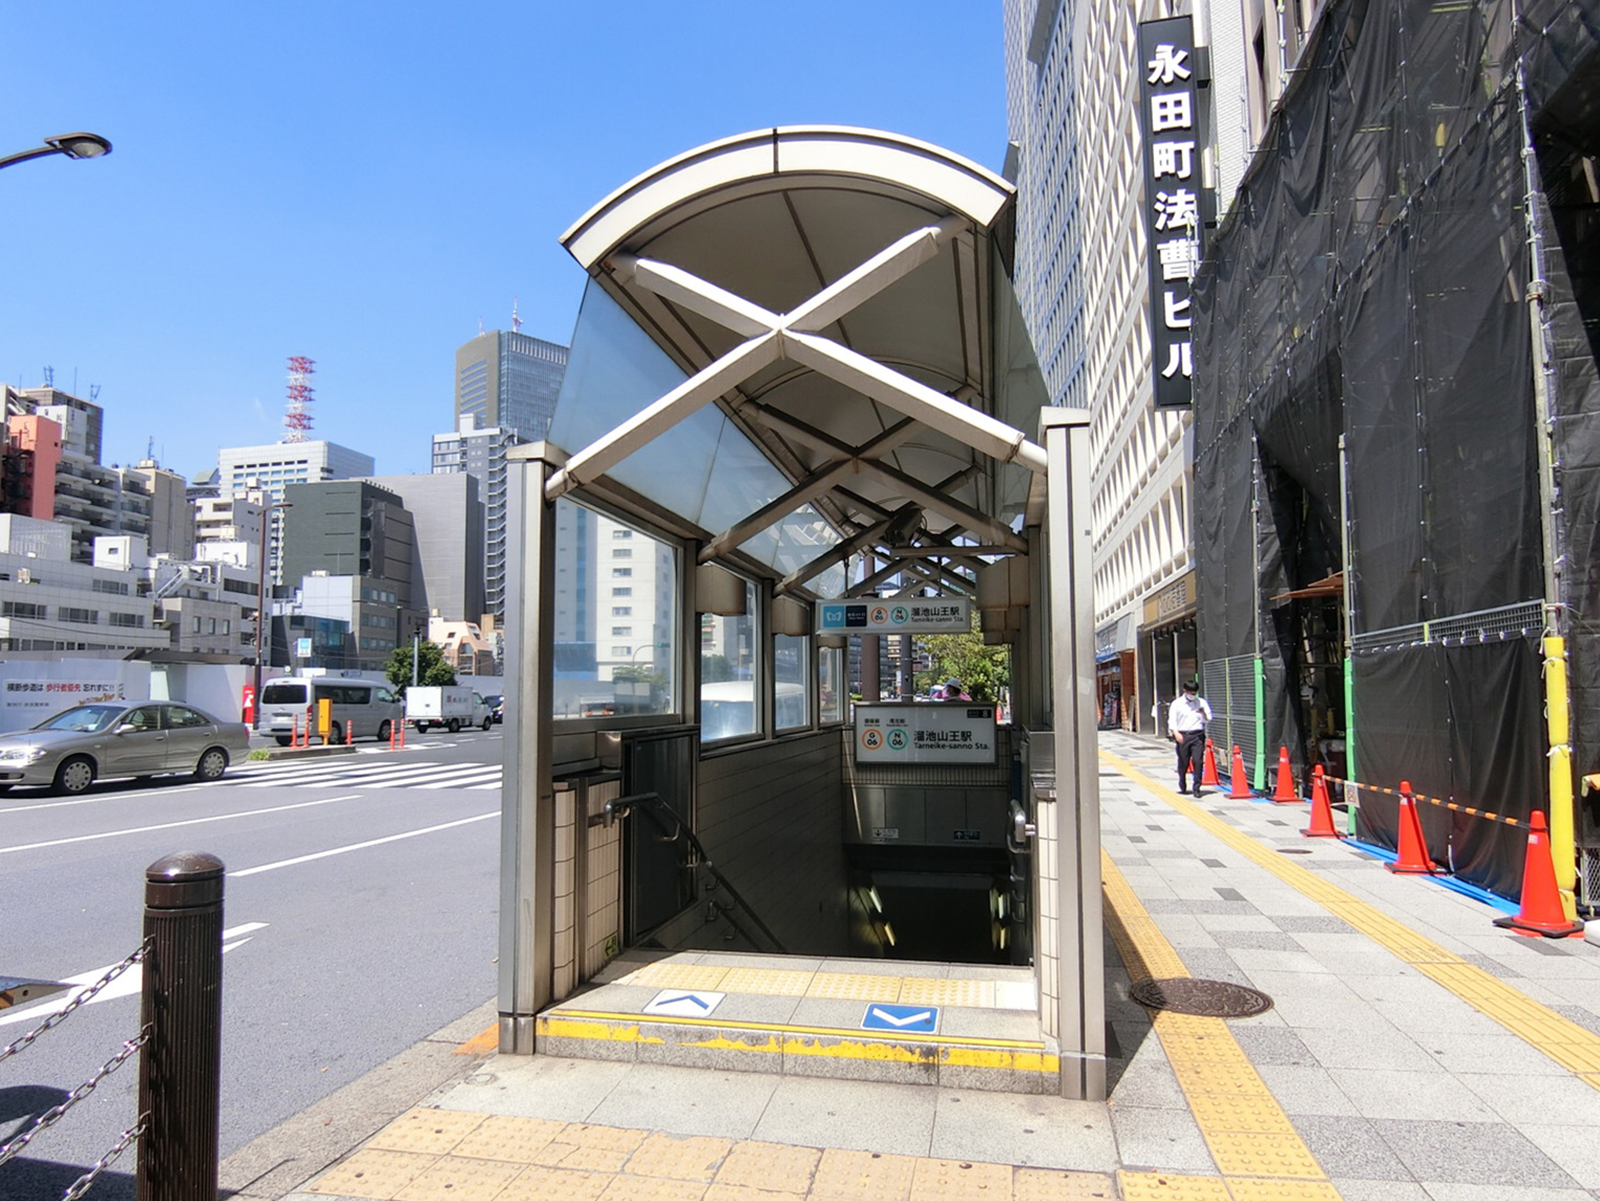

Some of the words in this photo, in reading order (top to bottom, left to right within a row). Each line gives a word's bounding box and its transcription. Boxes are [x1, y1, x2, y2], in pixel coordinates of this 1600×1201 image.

[911, 606, 960, 617] 溜池山王駅
[914, 730, 972, 742] 溜池山王駅
[914, 741, 973, 750] Tameike-sanno
[975, 742, 990, 750] Sta.
